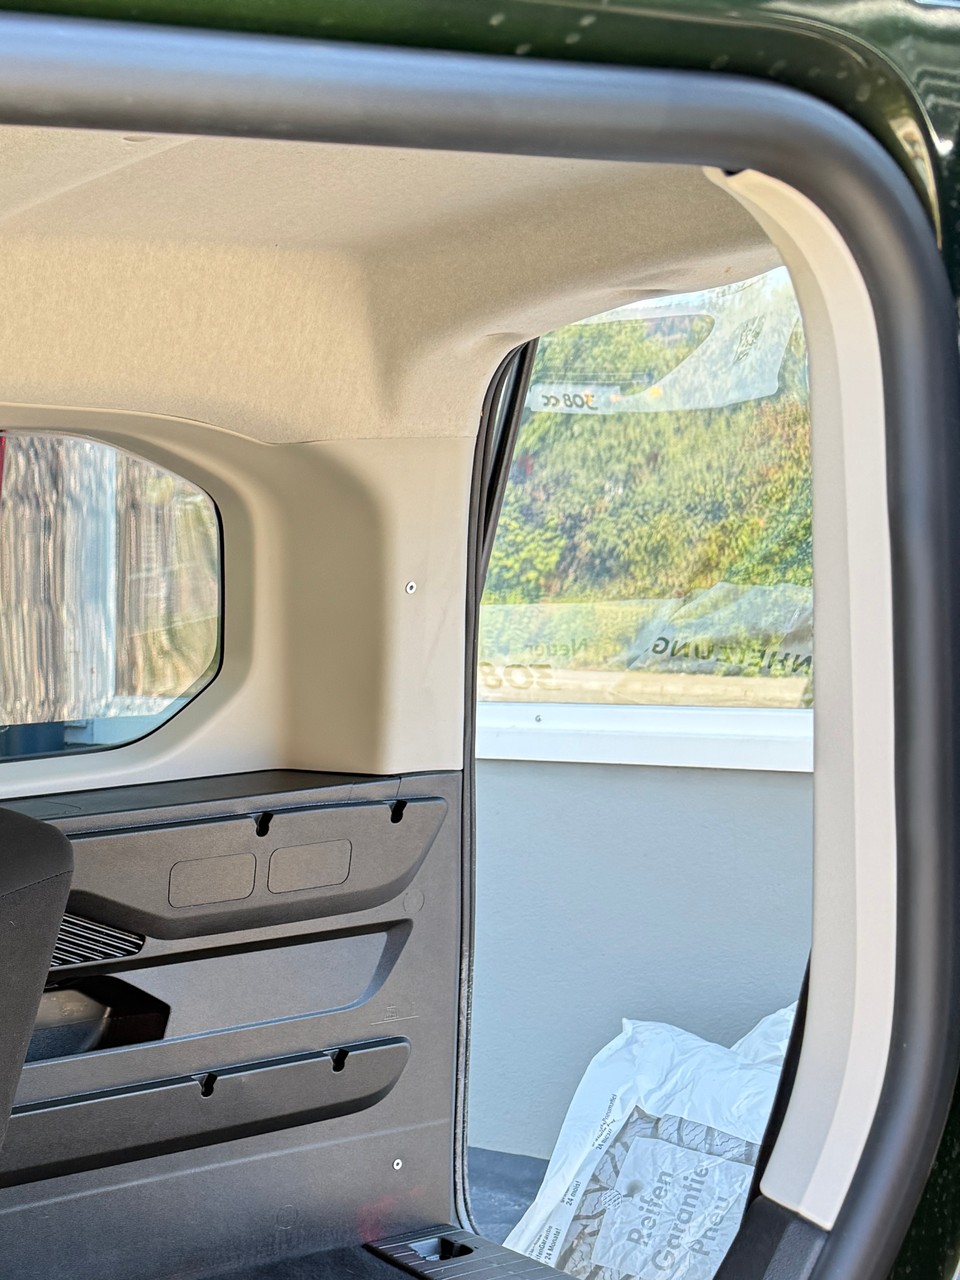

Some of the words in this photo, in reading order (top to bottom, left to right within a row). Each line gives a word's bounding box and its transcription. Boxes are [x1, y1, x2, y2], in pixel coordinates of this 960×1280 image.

[565, 1197, 574, 1207] 24
[626, 1169, 673, 1247] Reifen
[651, 1164, 710, 1273] Garantie
[535, 1225, 553, 1260] ifenGarantie
[547, 1227, 562, 1253] Monate!
[689, 1195, 731, 1258] Pneu
[544, 1252, 553, 1261] 24
